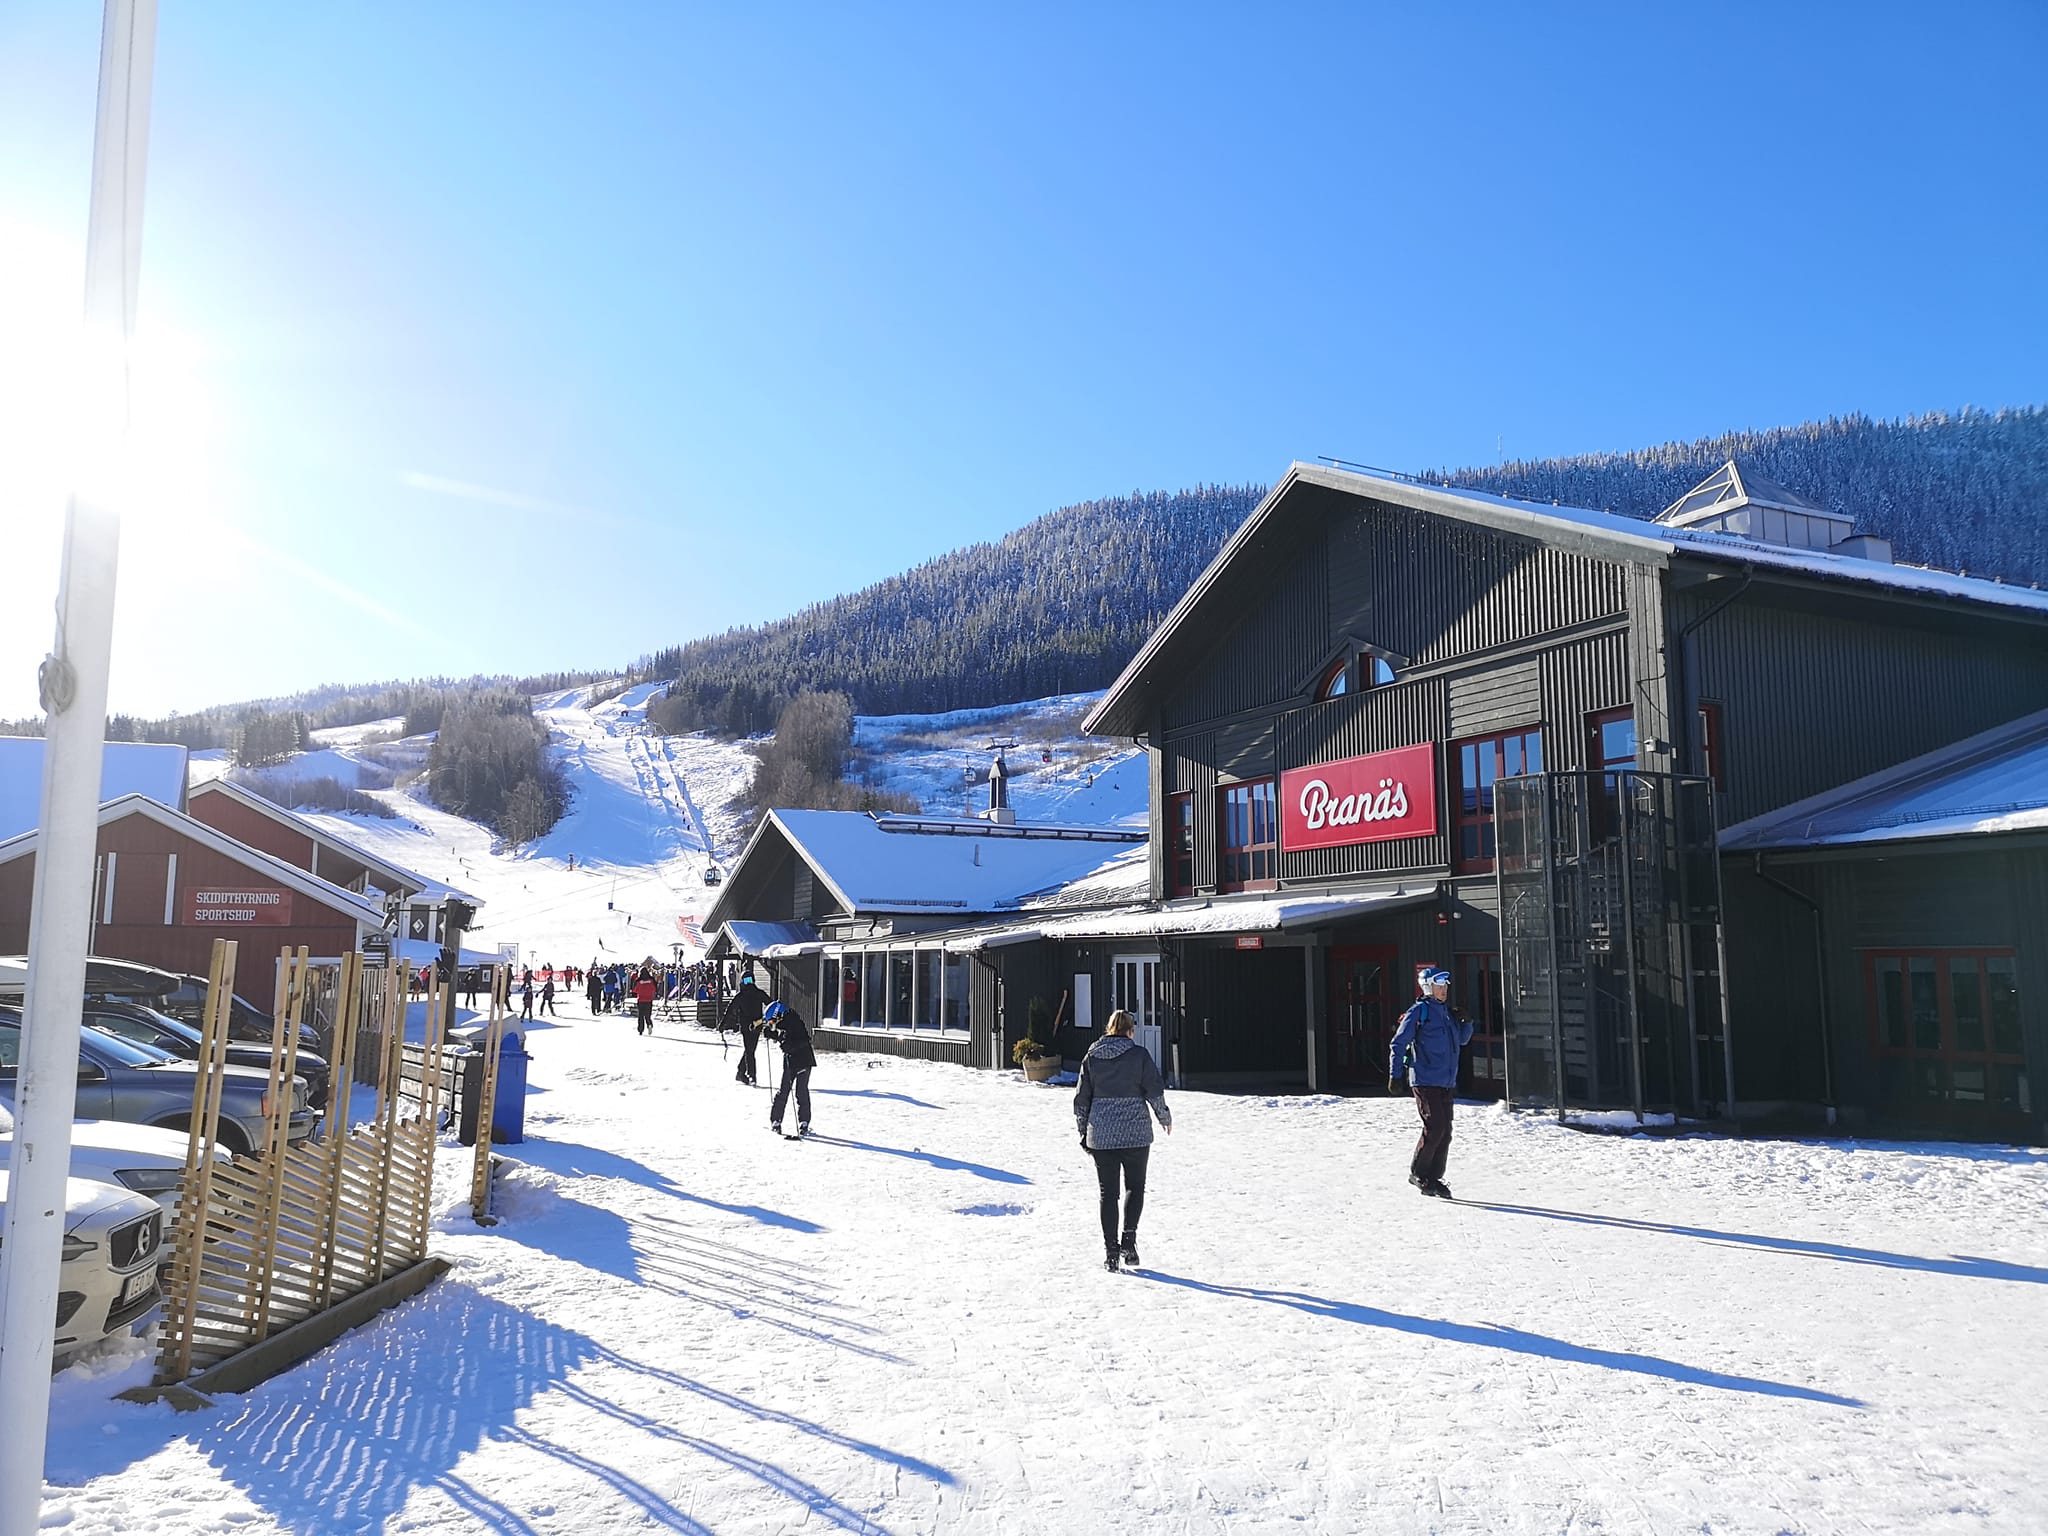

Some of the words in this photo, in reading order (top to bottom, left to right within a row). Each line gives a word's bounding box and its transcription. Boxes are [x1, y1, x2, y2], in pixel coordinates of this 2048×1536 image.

[1300, 778, 1408, 830] Branäs
[196, 892, 280, 904] SKIDUTHYRNING
[195, 909, 256, 920] SPORTSHOP
